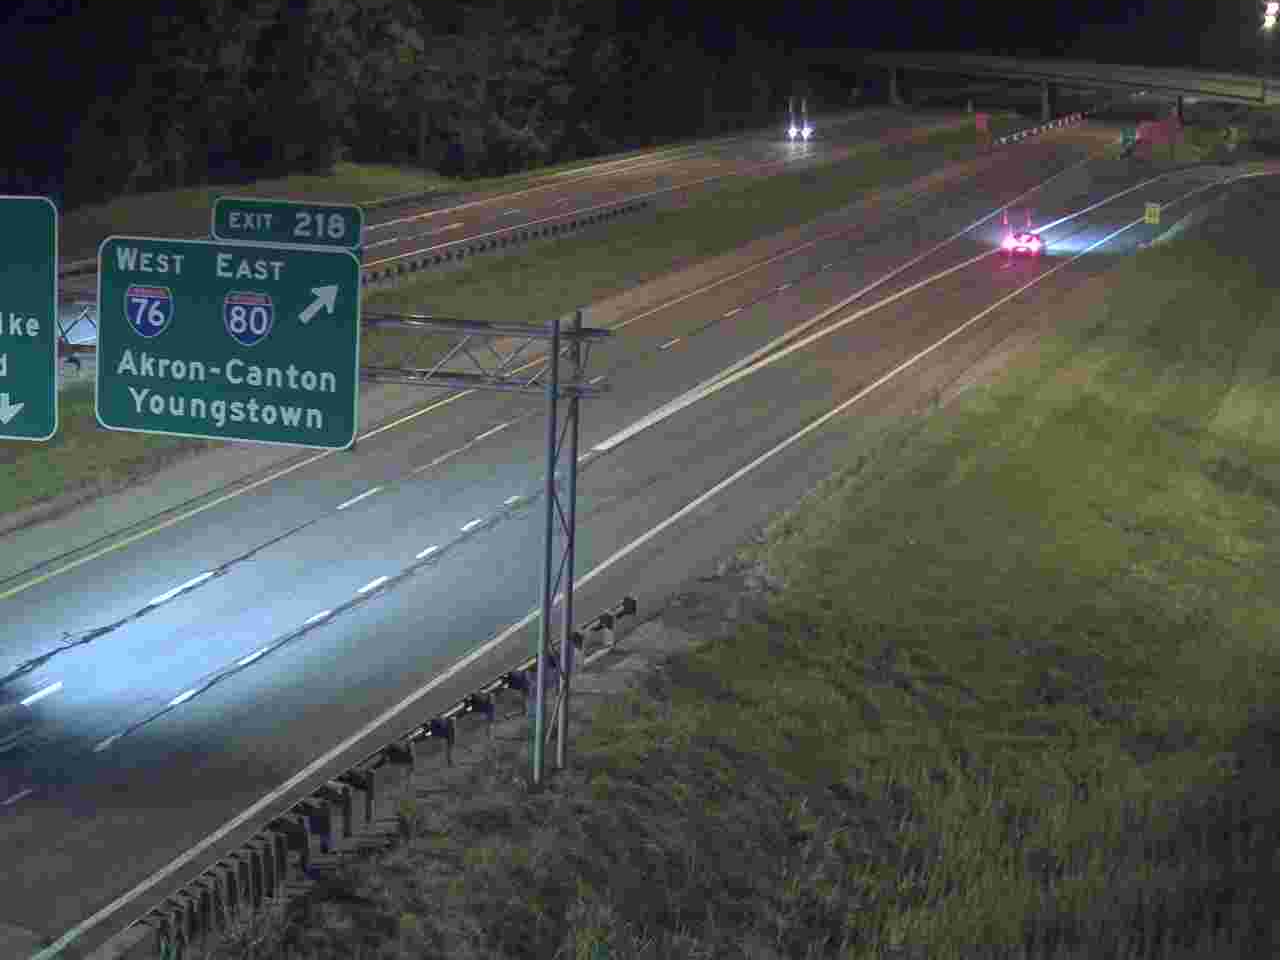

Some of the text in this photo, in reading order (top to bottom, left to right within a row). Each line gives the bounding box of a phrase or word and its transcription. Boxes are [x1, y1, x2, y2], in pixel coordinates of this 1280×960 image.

[228, 211, 346, 239] EXIT 218
[116, 248, 285, 281] WEST EAST
[131, 298, 269, 335] 76 80
[117, 349, 337, 393] Akron-Canton
[129, 387, 323, 429] Youngstown
